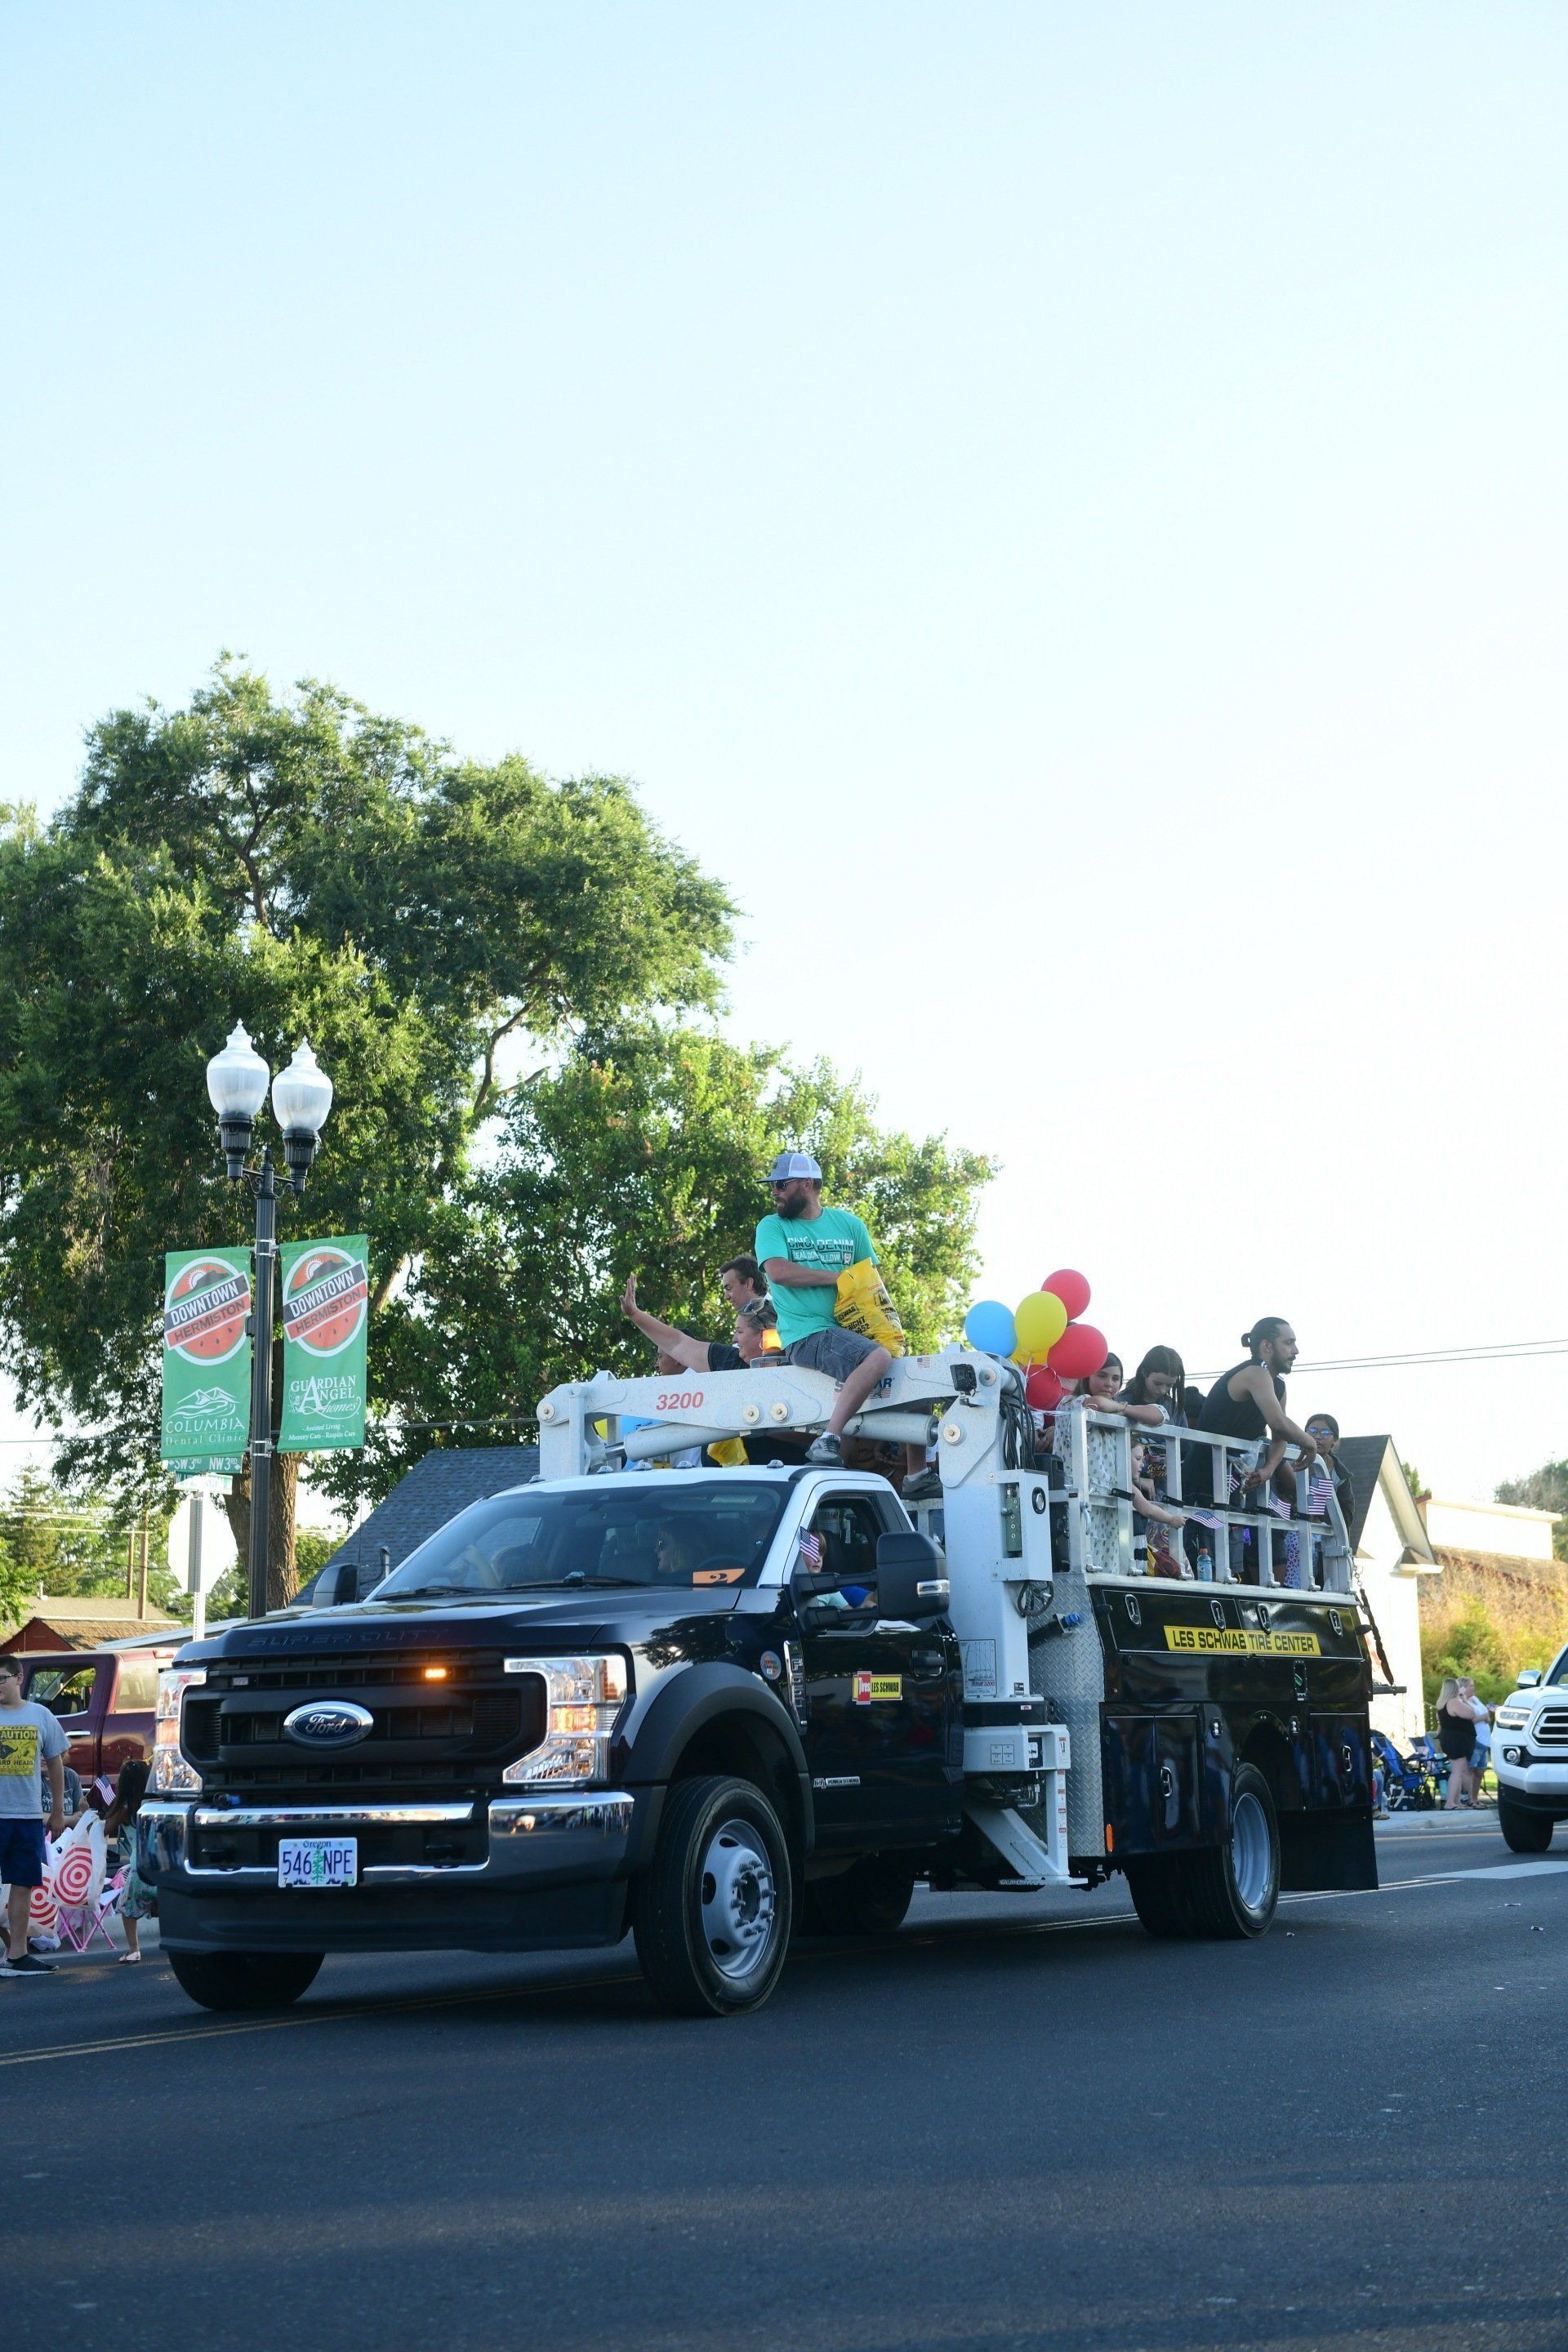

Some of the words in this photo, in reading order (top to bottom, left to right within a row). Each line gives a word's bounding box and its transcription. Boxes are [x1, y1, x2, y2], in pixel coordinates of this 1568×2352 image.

[817, 1239, 854, 1251] DENIM
[289, 1270, 355, 1317] DOWNTOWN
[171, 1281, 239, 1326] DOWNTOWN
[295, 1288, 361, 1334] HERMISTON
[174, 1299, 245, 1342] HERMISTON
[290, 1375, 356, 1392] GUARDIAN
[299, 1382, 355, 1412] ANGEL
[656, 1392, 704, 1411] 3200
[166, 1418, 245, 1434] COLUMBIA
[166, 1435, 203, 1446] Dental
[209, 1432, 246, 1443] Clinic
[174, 1457, 189, 1470] SW
[209, 1457, 224, 1470] NW
[224, 1457, 238, 1470] 3RD
[1173, 1630, 1196, 1648] LES
[1198, 1631, 1247, 1650] SCHWAB
[1248, 1633, 1272, 1650] TIRE
[1274, 1635, 1316, 1652] CENTER
[858, 1677, 871, 1695] Tires
[871, 1682, 880, 1693] LES
[880, 1682, 900, 1693] SCHWAB
[305, 1713, 347, 1735] Ford
[0, 1731, 37, 1740] AUTION
[303, 1840, 332, 1849] Oregon
[283, 1851, 312, 1875] 546
[323, 1850, 353, 1874] NPE
